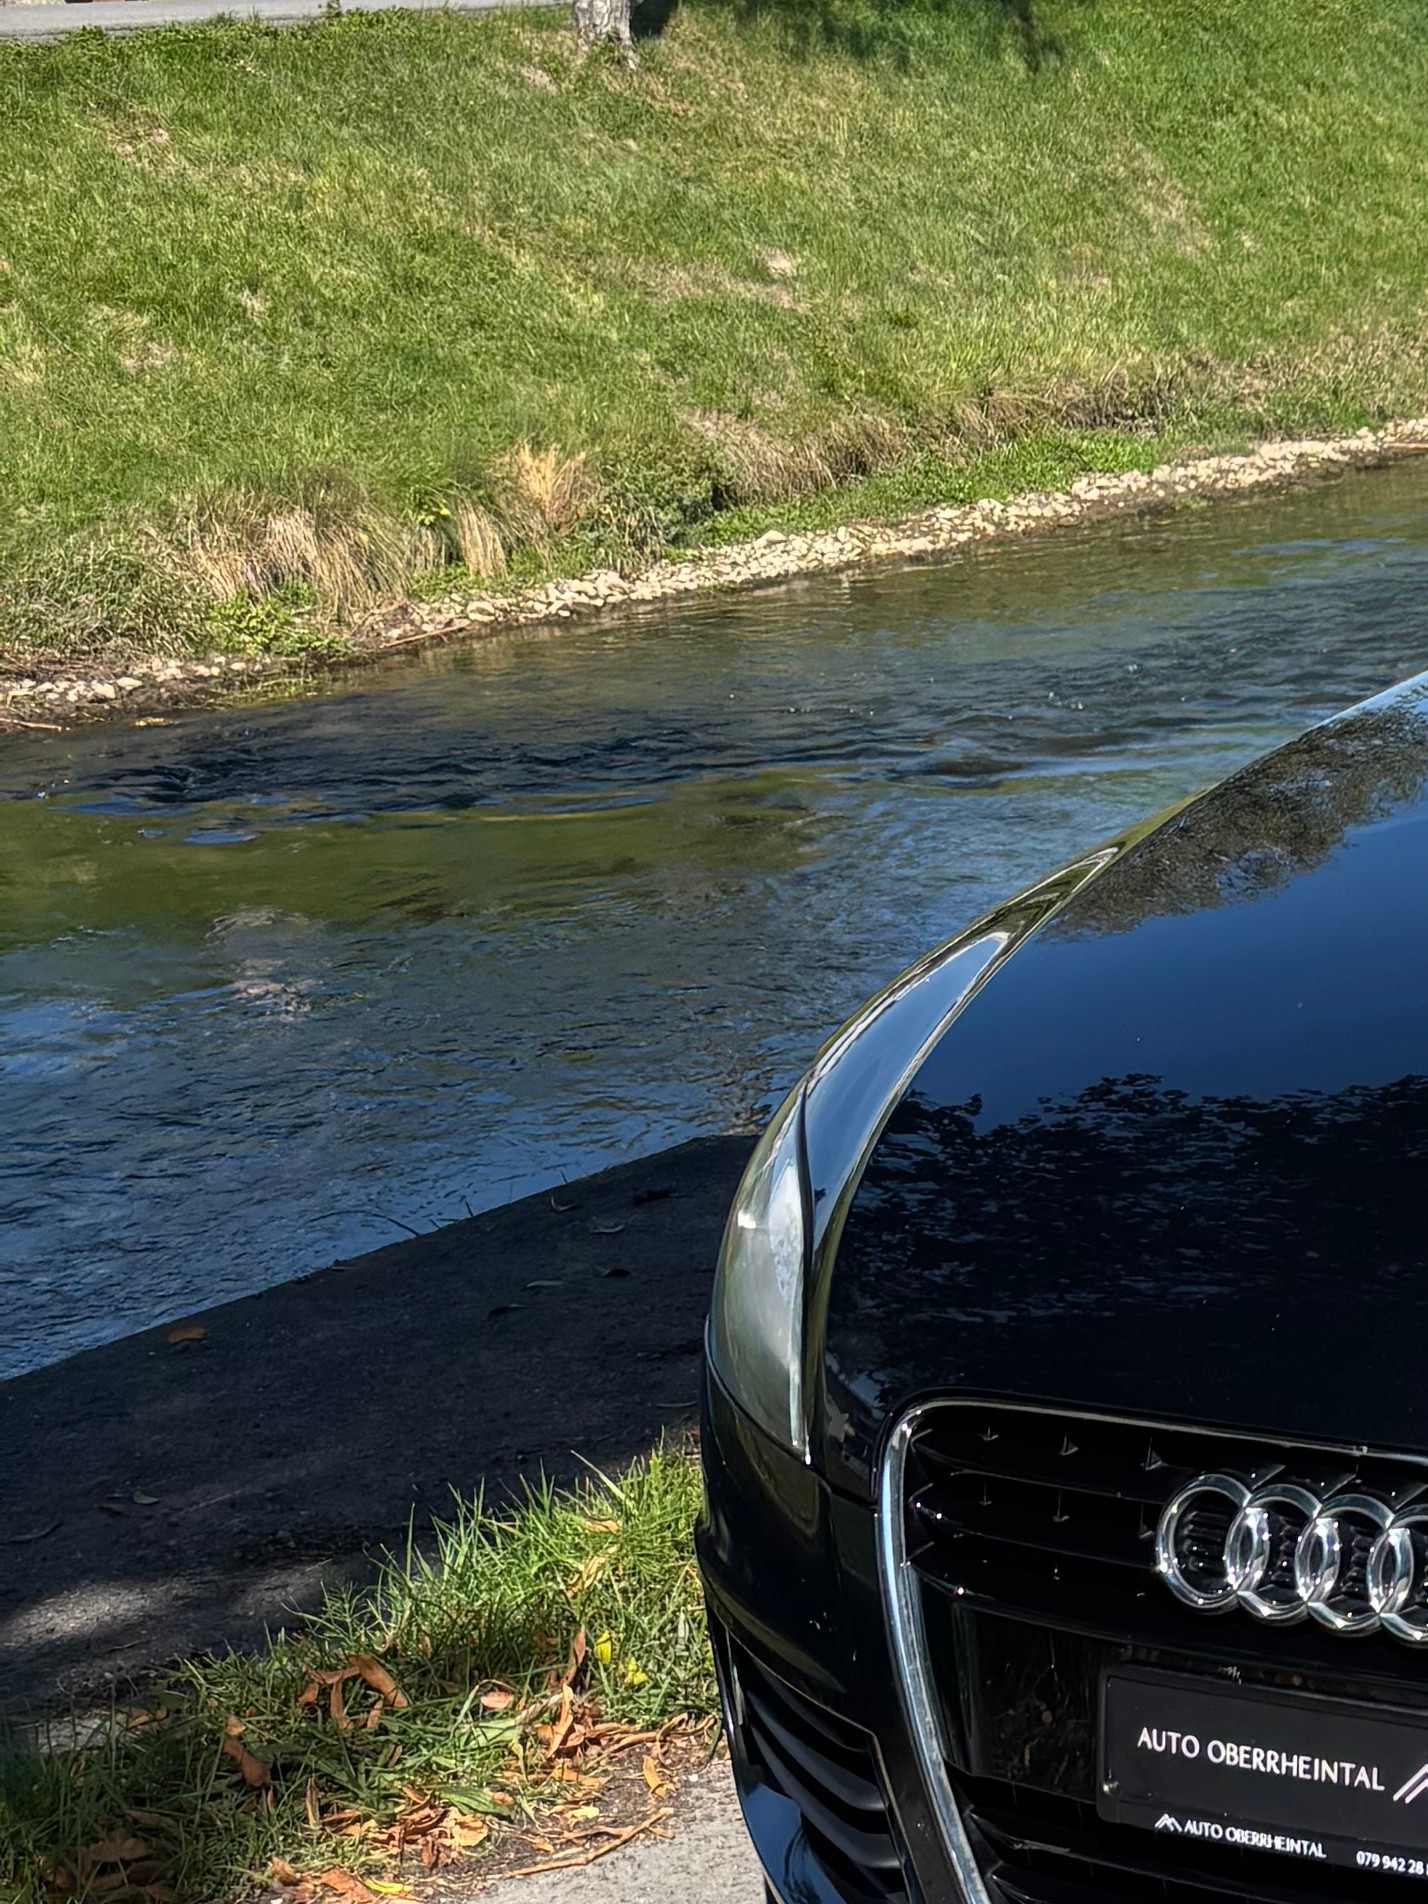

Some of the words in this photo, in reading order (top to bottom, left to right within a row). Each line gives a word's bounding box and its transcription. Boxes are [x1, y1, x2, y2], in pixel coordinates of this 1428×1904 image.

[1137, 1726, 1200, 1759] AUTO
[1206, 1739, 1386, 1791] OBERRHEINTAL
[1184, 1819, 1223, 1840] AUTO
[1225, 1826, 1328, 1859] OBERRHEINTAL
[1355, 1849, 1380, 1868] 079
[1382, 1855, 1406, 1873] 942
[1407, 1859, 1425, 1875] 28
